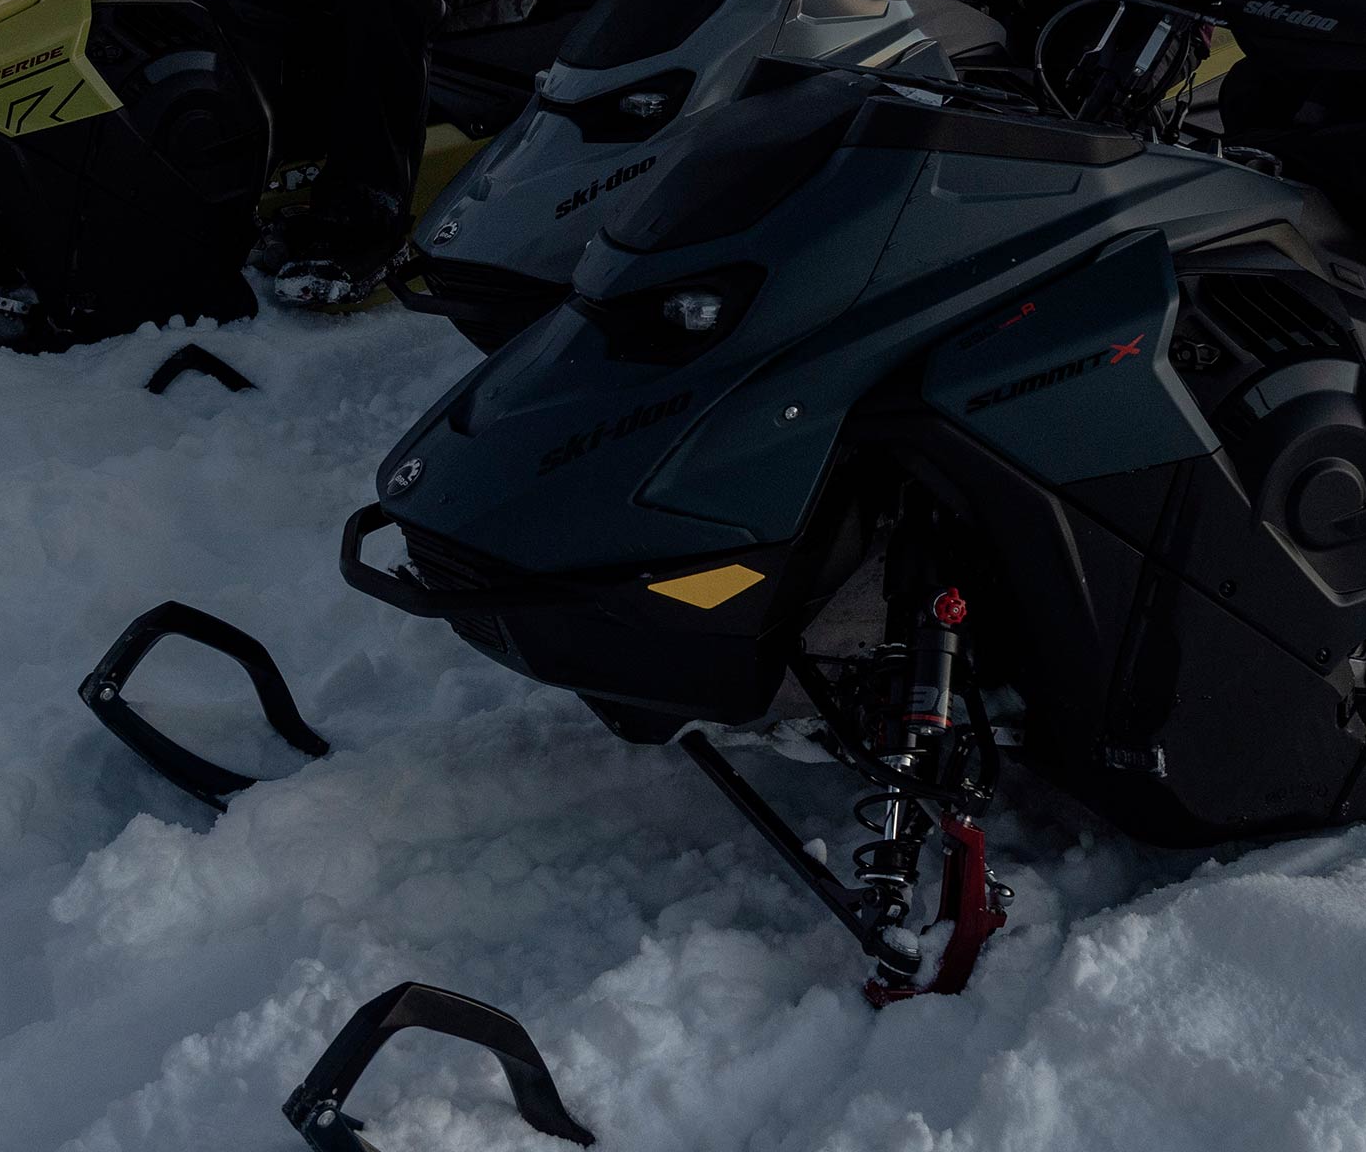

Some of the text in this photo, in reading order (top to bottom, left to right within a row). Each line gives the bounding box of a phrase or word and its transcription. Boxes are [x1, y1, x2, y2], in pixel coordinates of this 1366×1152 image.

[1243, 0, 1339, 32] ski-doo
[555, 156, 657, 219] ski-doo
[966, 332, 1146, 414] SUMMIT X
[538, 391, 693, 477] ski-doo
